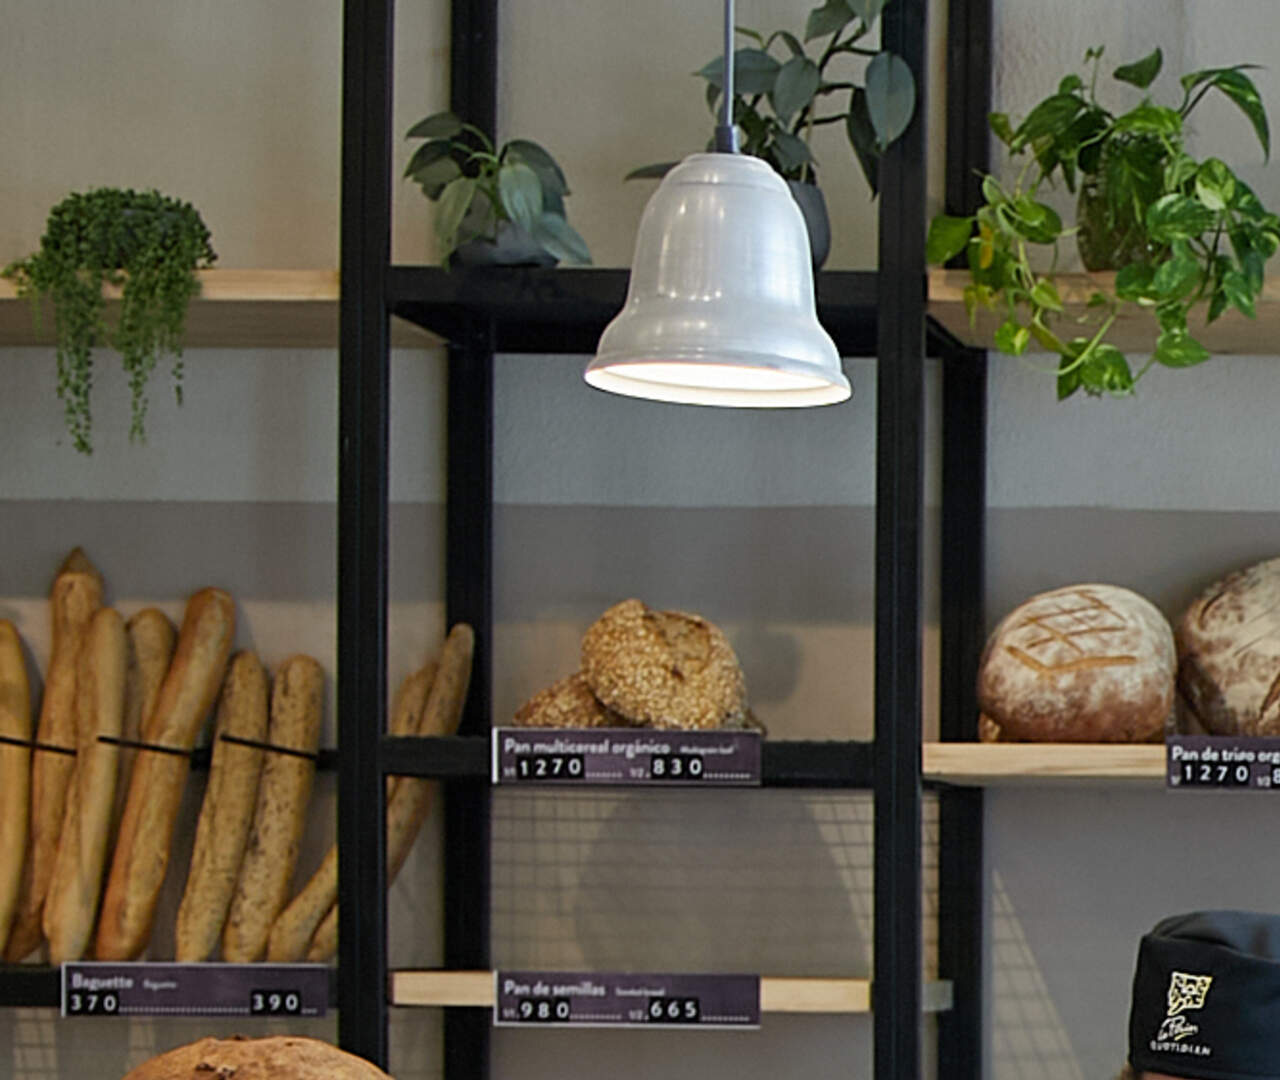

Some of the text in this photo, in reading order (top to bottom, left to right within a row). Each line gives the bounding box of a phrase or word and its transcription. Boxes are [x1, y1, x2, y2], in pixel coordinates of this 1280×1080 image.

[504, 737, 531, 753] Pan
[1172, 745, 1199, 761] Pan
[1201, 745, 1219, 761] de
[521, 758, 582, 776] 1270
[653, 758, 702, 776] 830
[1185, 765, 1249, 782] 1270
[72, 974, 134, 990] Baguette
[503, 979, 530, 996] Pan
[532, 981, 550, 996] de
[552, 981, 606, 997] semillas
[71, 995, 117, 1012] 370
[253, 994, 299, 1012] 390
[520, 1002, 569, 1018] 980
[650, 1001, 697, 1018] 665
